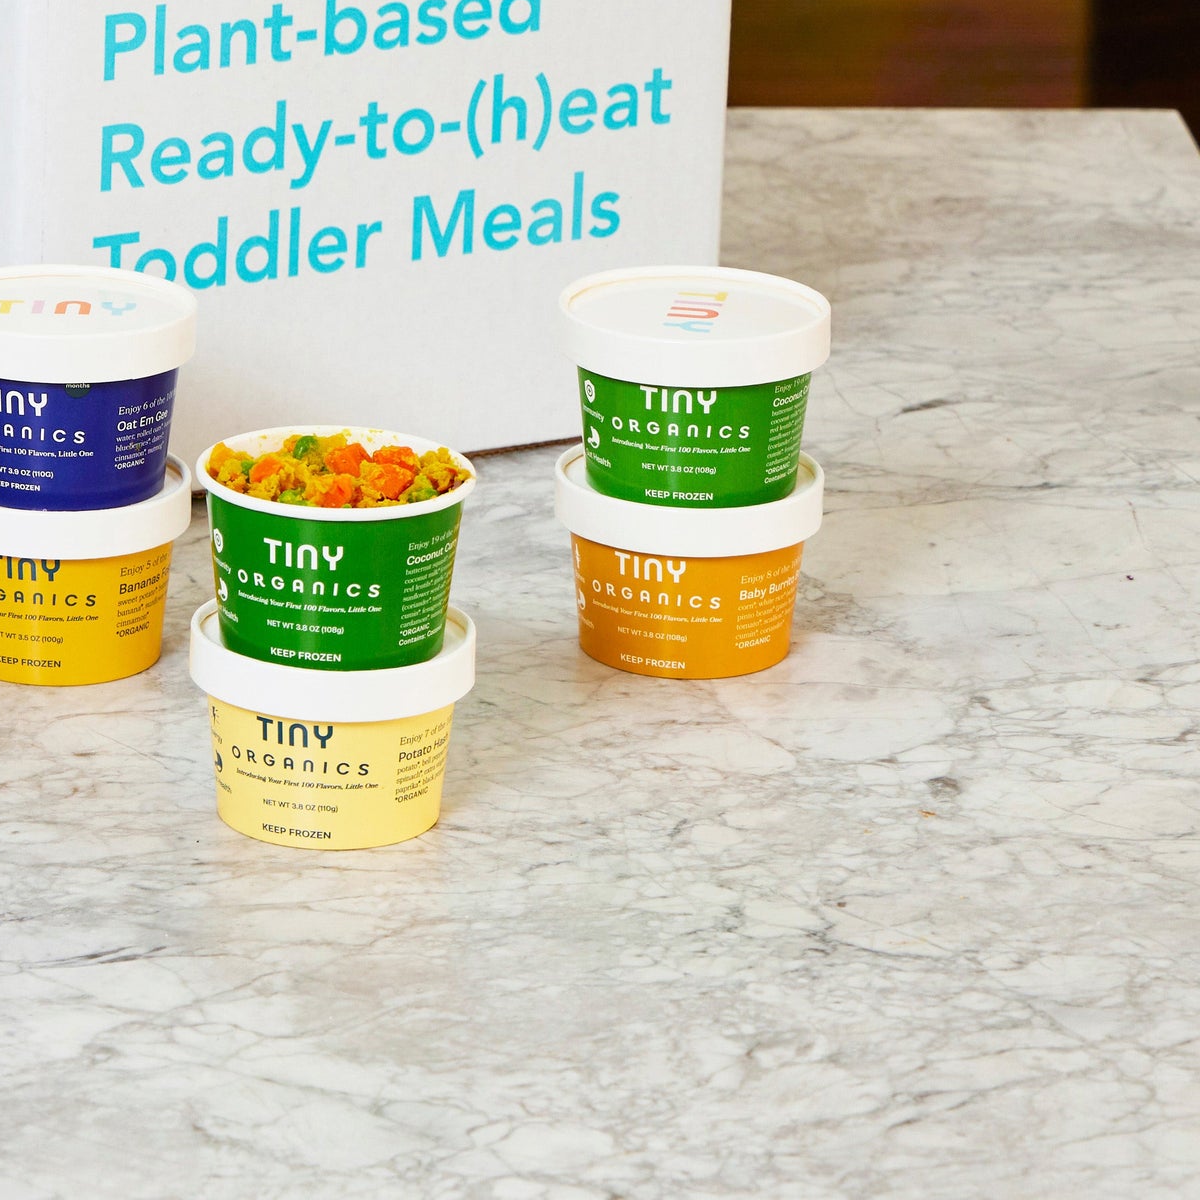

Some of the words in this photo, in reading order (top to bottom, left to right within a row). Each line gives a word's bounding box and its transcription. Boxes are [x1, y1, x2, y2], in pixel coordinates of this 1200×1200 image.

[99, 66, 673, 193] Ready-to-(h)eat
[93, 205, 384, 289] Toddler
[411, 171, 621, 263] Meals
[663, 292, 729, 333] TINY
[640, 386, 717, 414] TINY
[772, 389, 802, 408] Coconut
[117, 419, 137, 432] Oat
[139, 415, 154, 427] Em
[155, 408, 169, 422] Gee
[611, 417, 750, 439] ORGANICS
[11, 481, 41, 492] FROZEN
[645, 488, 670, 498] KEEP
[672, 491, 714, 501] FROZEN
[263, 537, 344, 571] TINY
[407, 548, 443, 566] Coconut
[614, 551, 686, 583] TINY
[119, 575, 160, 595] Bananas
[237, 568, 381, 598] ORGANICS
[592, 580, 721, 609] ORGANICS
[739, 588, 766, 601] Baby
[768, 576, 796, 594] Burrito
[267, 619, 281, 628] NET
[282, 621, 294, 630] WT
[296, 623, 307, 631] 3.8
[309, 625, 320, 633] OZ
[321, 625, 344, 635] (108g)
[21, 658, 61, 668] FROZEN
[271, 647, 296, 658] KEEP
[298, 650, 341, 663] FROZEN
[620, 653, 643, 664] KEEP
[645, 657, 685, 669] FROZEN
[256, 716, 334, 749] TINY
[232, 745, 369, 776] ORGANICS
[398, 744, 432, 762] Potato
[262, 823, 287, 834] KEEP
[289, 828, 331, 839] FROZEN
